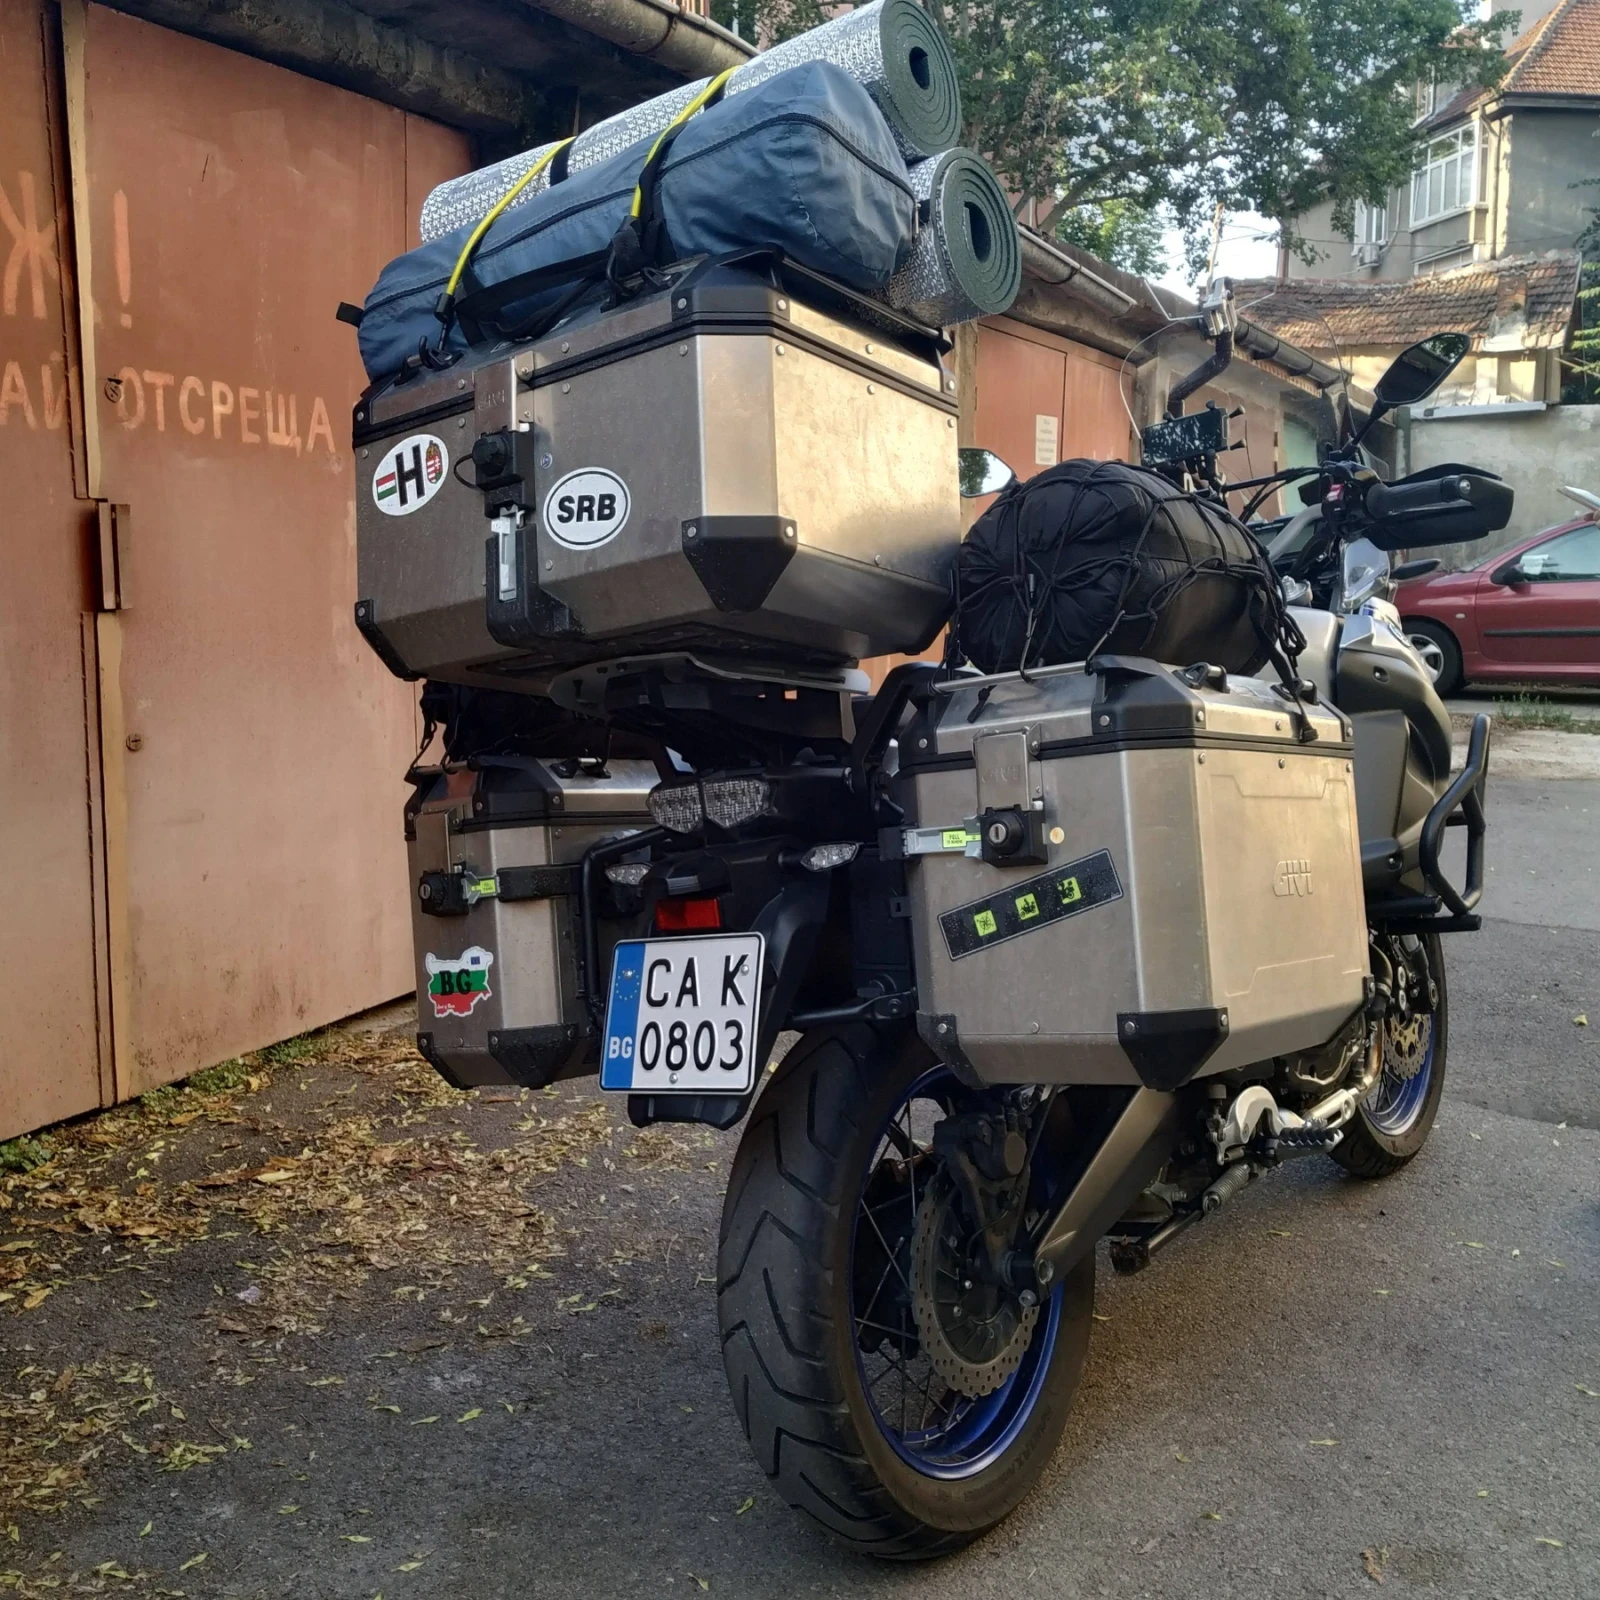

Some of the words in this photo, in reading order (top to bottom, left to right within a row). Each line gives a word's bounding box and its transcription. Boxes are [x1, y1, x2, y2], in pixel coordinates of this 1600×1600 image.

[116, 366, 336, 457] ОТСРЕЩА
[395, 443, 425, 507] H
[557, 493, 617, 523] SRB
[439, 968, 473, 996] BG
[645, 956, 701, 1007] CA
[720, 953, 750, 1006] K
[608, 1036, 633, 1059] BG
[639, 1018, 745, 1072] 0803
